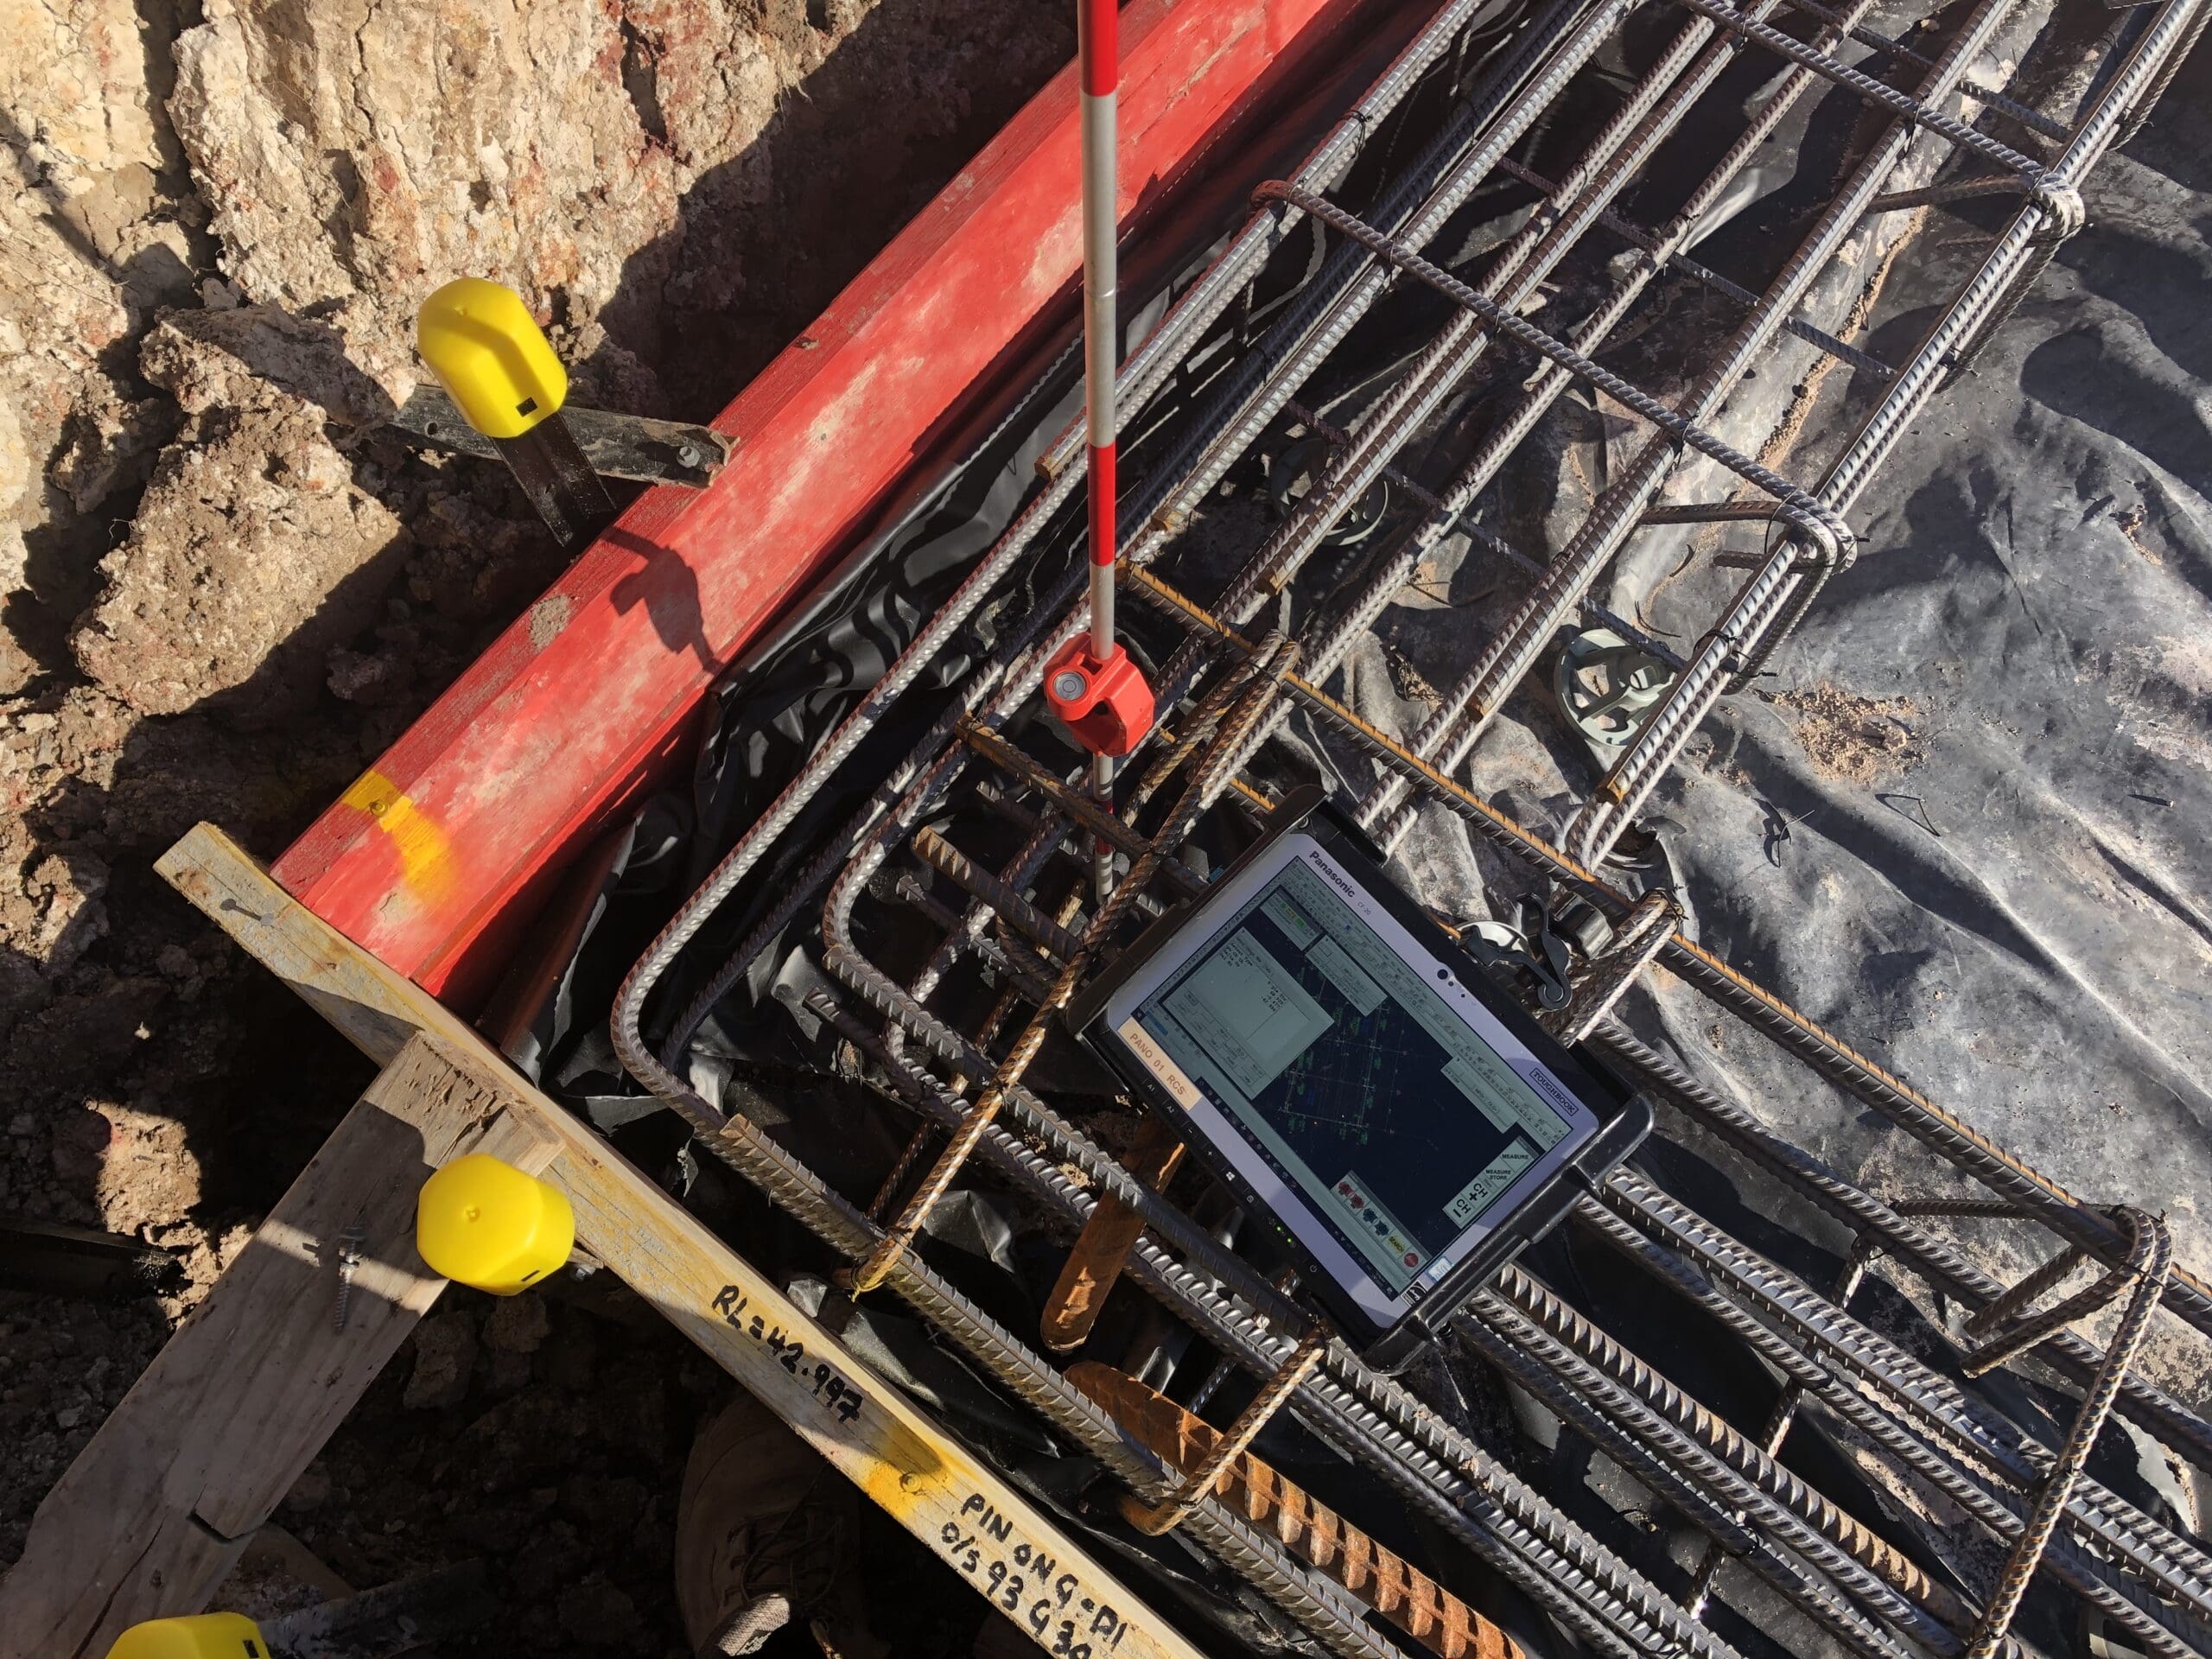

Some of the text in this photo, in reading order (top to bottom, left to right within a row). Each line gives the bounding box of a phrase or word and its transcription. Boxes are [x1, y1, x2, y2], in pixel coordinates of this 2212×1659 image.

[1309, 851, 1355, 897] Panasonic
[1129, 1033, 1185, 1096] PANO 01 RCS
[1532, 1071, 1576, 1114] TOUGHBOOK
[1457, 1198, 1471, 1214] CH
[1473, 1183, 1488, 1198] CH
[1389, 1236, 1404, 1253] SEARCH
[960, 1493, 1013, 1542] PIN
